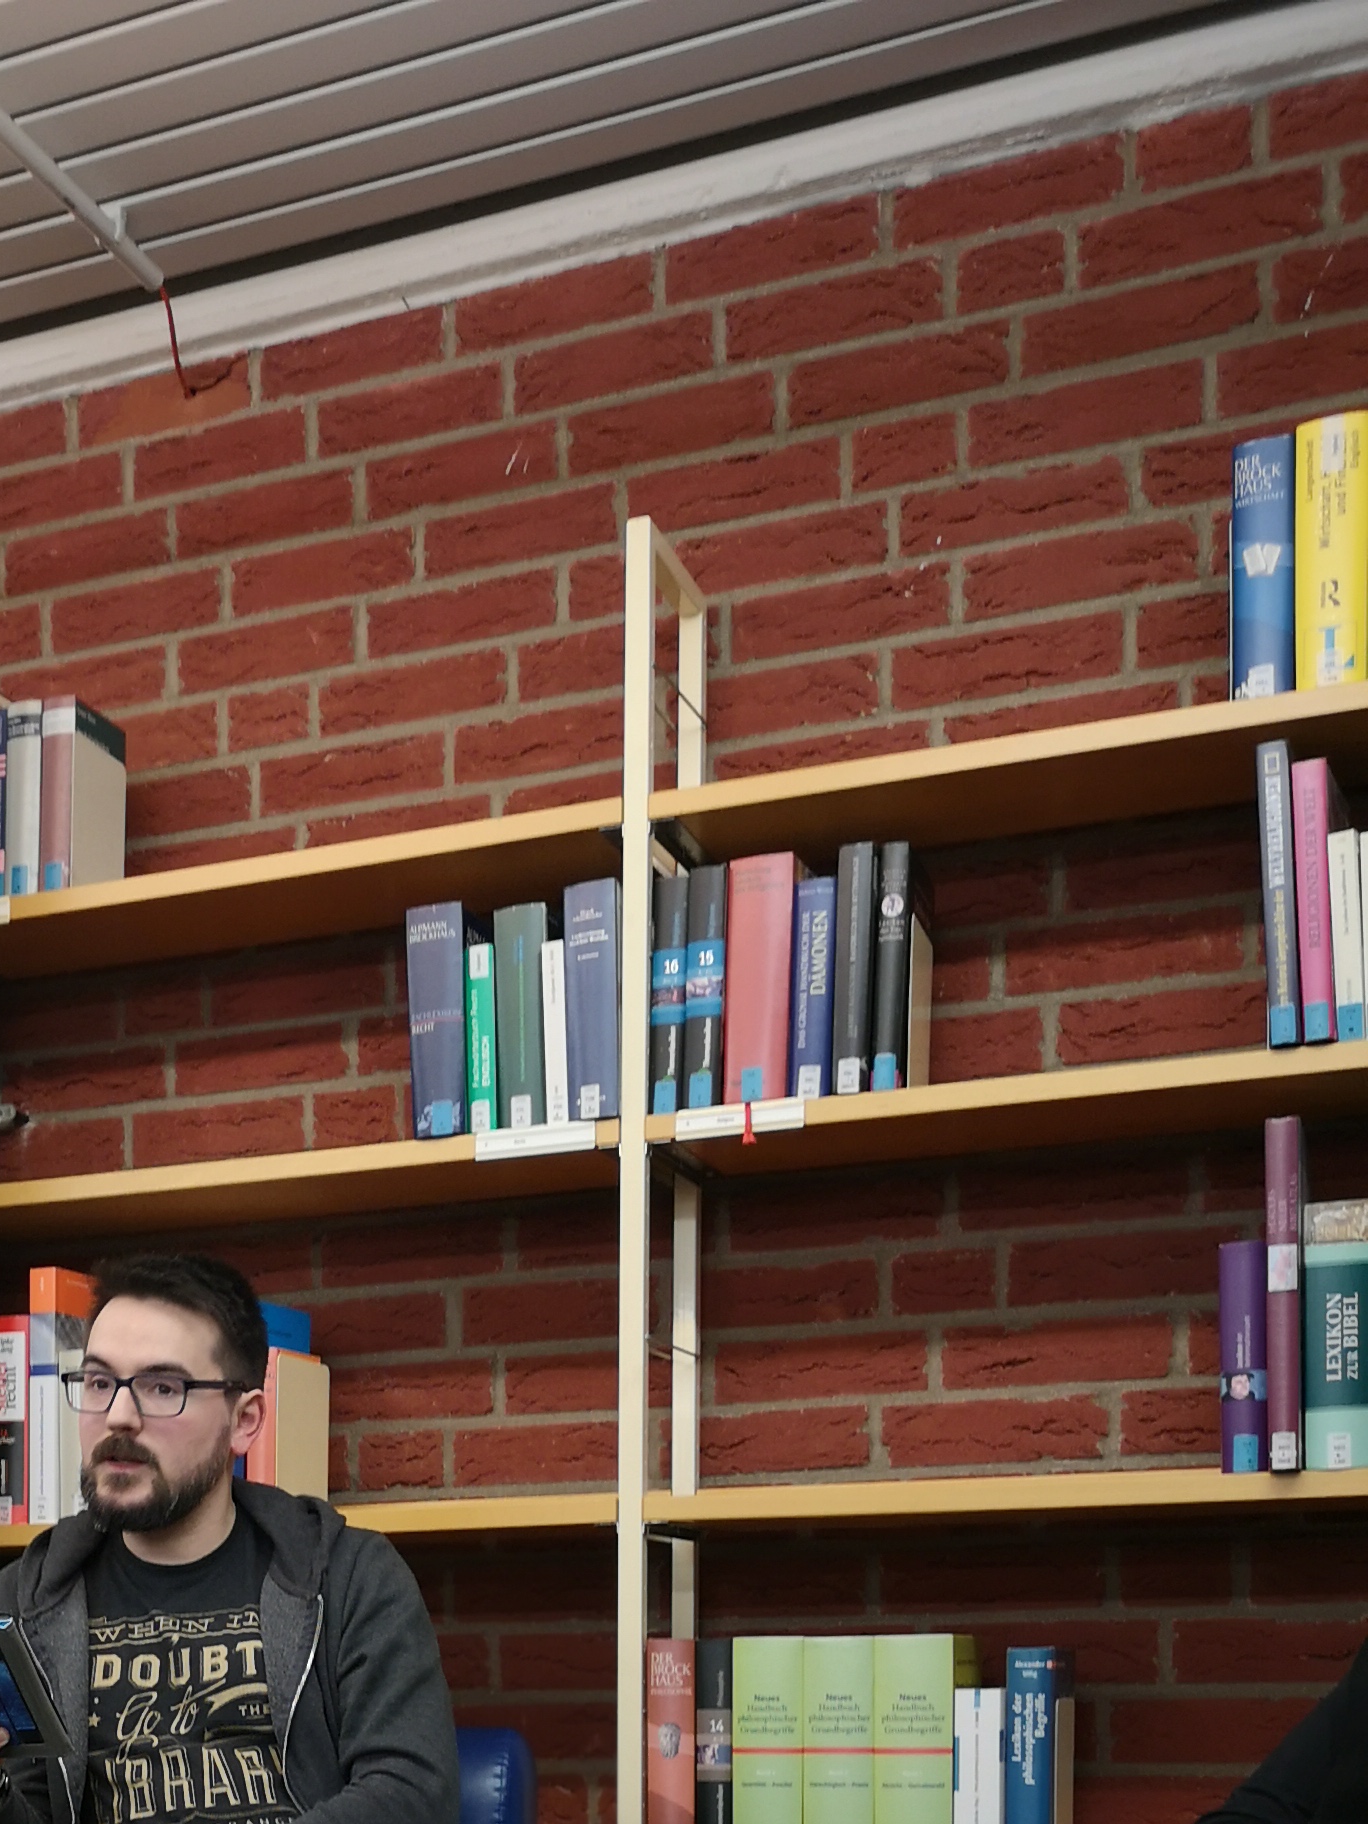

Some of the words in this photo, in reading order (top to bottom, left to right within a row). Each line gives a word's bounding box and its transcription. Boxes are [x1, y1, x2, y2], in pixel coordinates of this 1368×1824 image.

[1342, 1291, 1359, 1348] BIBEL
[1326, 1292, 1342, 1382] LEXIKON
[1346, 1349, 1359, 1380] ZUR
[3, 1366, 17, 1409] recht
[90, 1614, 217, 1643] WHEN
[90, 1639, 264, 1690] DOUBT
[753, 1693, 781, 1702] Neues
[825, 1693, 854, 1702] Neues
[898, 1693, 928, 1702] Neues
[115, 1690, 164, 1764] Go
[169, 1677, 229, 1736] to
[709, 1718, 725, 1734] 14
